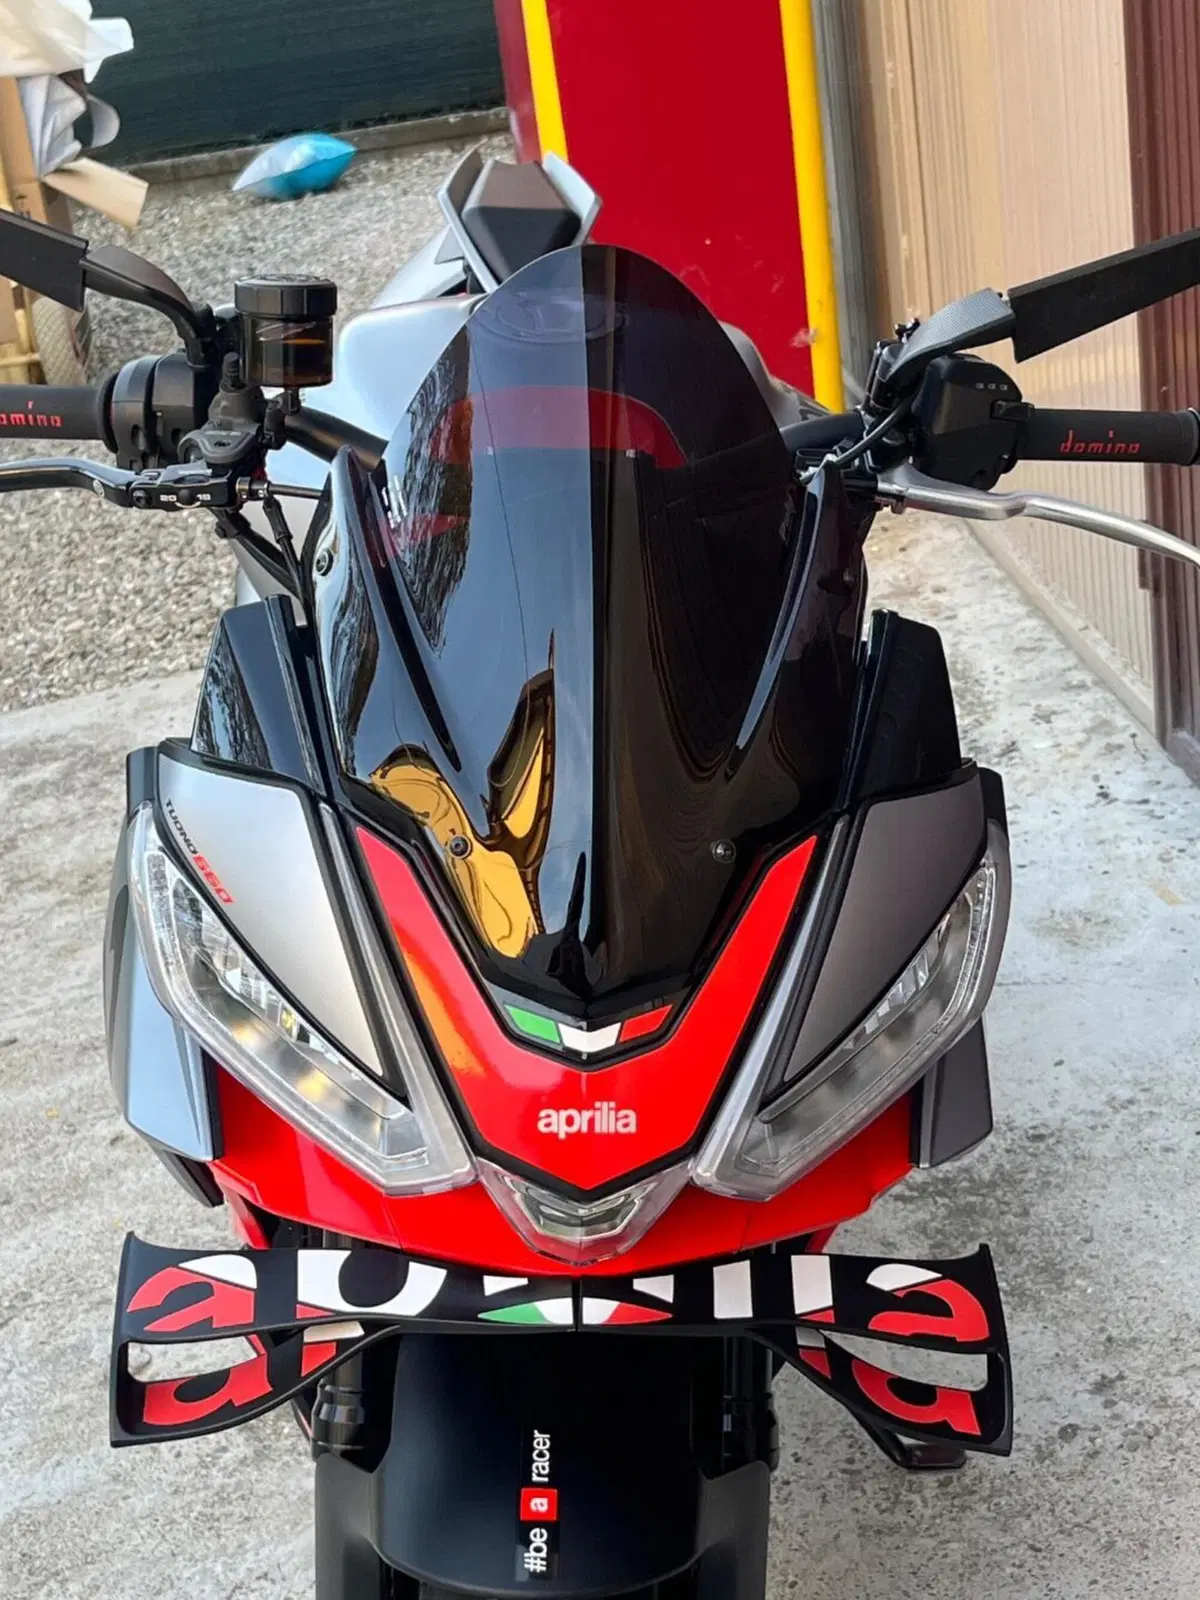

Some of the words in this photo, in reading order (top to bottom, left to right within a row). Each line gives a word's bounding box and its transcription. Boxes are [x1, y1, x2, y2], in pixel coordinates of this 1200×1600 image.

[0, 400, 62, 428] omino
[1059, 429, 1141, 454] domino
[537, 1101, 637, 1140] aprilia
[532, 1429, 551, 1482] racer
[530, 1497, 549, 1513] a
[524, 1527, 548, 1573] #be
